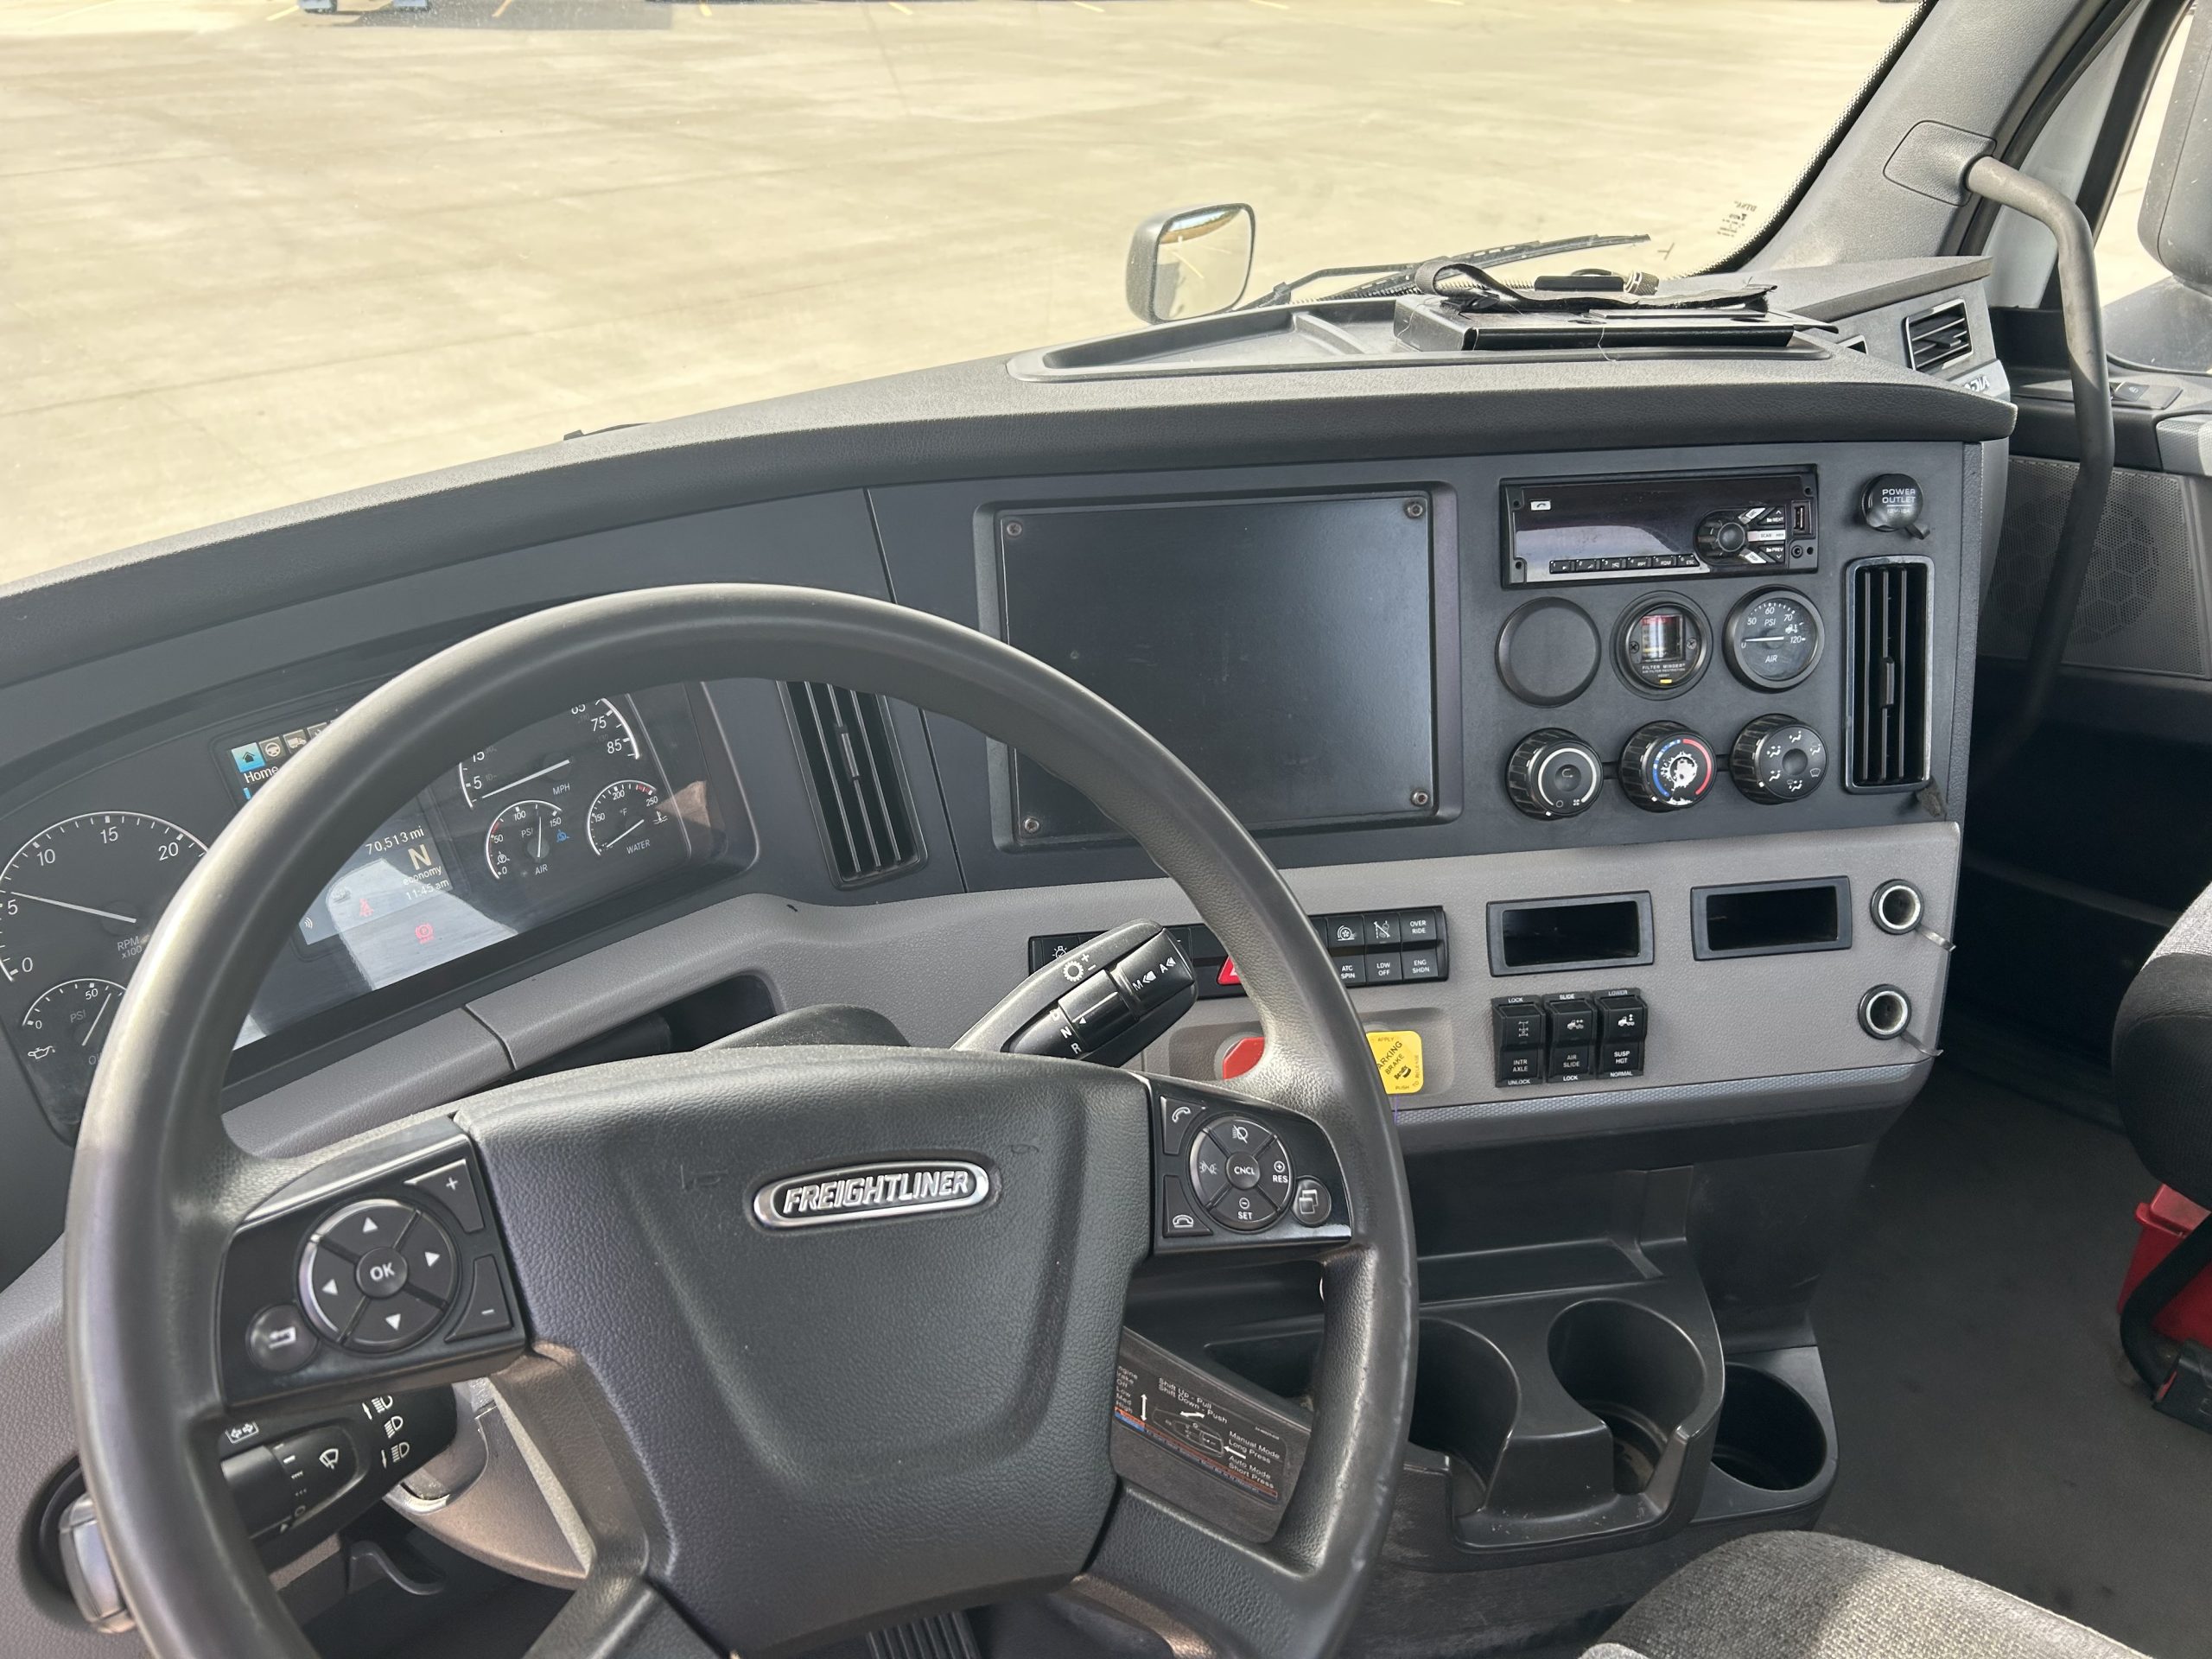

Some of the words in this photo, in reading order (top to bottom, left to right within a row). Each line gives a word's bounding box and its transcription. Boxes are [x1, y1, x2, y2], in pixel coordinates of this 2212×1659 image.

[1790, 635, 1802, 644] 120
[1764, 654, 1777, 663] AIR
[591, 715, 607, 732] 75
[607, 738, 622, 753] 85
[474, 775, 482, 790] 5
[552, 783, 570, 796] MPH
[612, 790, 625, 800] 200
[645, 796, 658, 807] 250
[513, 810, 526, 821] 100
[549, 817, 562, 827] 150
[594, 812, 606, 823] 150
[100, 826, 119, 844] 15
[365, 831, 409, 855] 70,513
[410, 825, 425, 838] mi
[493, 833, 504, 843] 50
[521, 827, 533, 838] PSI
[158, 841, 180, 861] 20
[626, 839, 651, 855] WATER
[36, 848, 56, 867] 10
[408, 843, 432, 871] N
[403, 865, 442, 887] economy
[502, 866, 507, 875] 0
[534, 864, 548, 876] AIR
[435, 879, 449, 892] am
[7, 899, 18, 915] 5
[117, 935, 140, 951] RPM
[22, 957, 34, 973] 0
[1159, 963, 1168, 974] A
[1132, 979, 1144, 991] M
[85, 988, 99, 1001] 50
[70, 1008, 86, 1023] PSI
[35, 1020, 42, 1030] 0
[1060, 1026, 1072, 1039] N
[1071, 1042, 1082, 1054] R
[1376, 1040, 1403, 1071] ARKING
[1384, 1053, 1405, 1075] BRAKE
[1233, 1166, 1255, 1175] CNCL
[1272, 1174, 1288, 1183] RES
[782, 1170, 969, 1214] FREIGHTLINER
[1237, 1211, 1253, 1220] SET
[369, 1262, 396, 1282] OK
[1116, 1385, 1131, 1398] Low
[1159, 1377, 1176, 1391] Shift
[1178, 1388, 1190, 1399] Up
[1197, 1397, 1212, 1409] Pull
[1158, 1383, 1176, 1398] Shift
[1178, 1394, 1200, 1410] Down
[1207, 1408, 1228, 1424] Push
[1229, 1430, 1257, 1448] Manual
[1258, 1445, 1281, 1459] Mode
[1229, 1439, 1248, 1453] Long
[1249, 1448, 1271, 1464] Press
[1229, 1455, 1248, 1468] Auto
[1249, 1465, 1271, 1479] Mode
[1229, 1462, 1249, 1478] Short
[1251, 1473, 1274, 1489] Press
